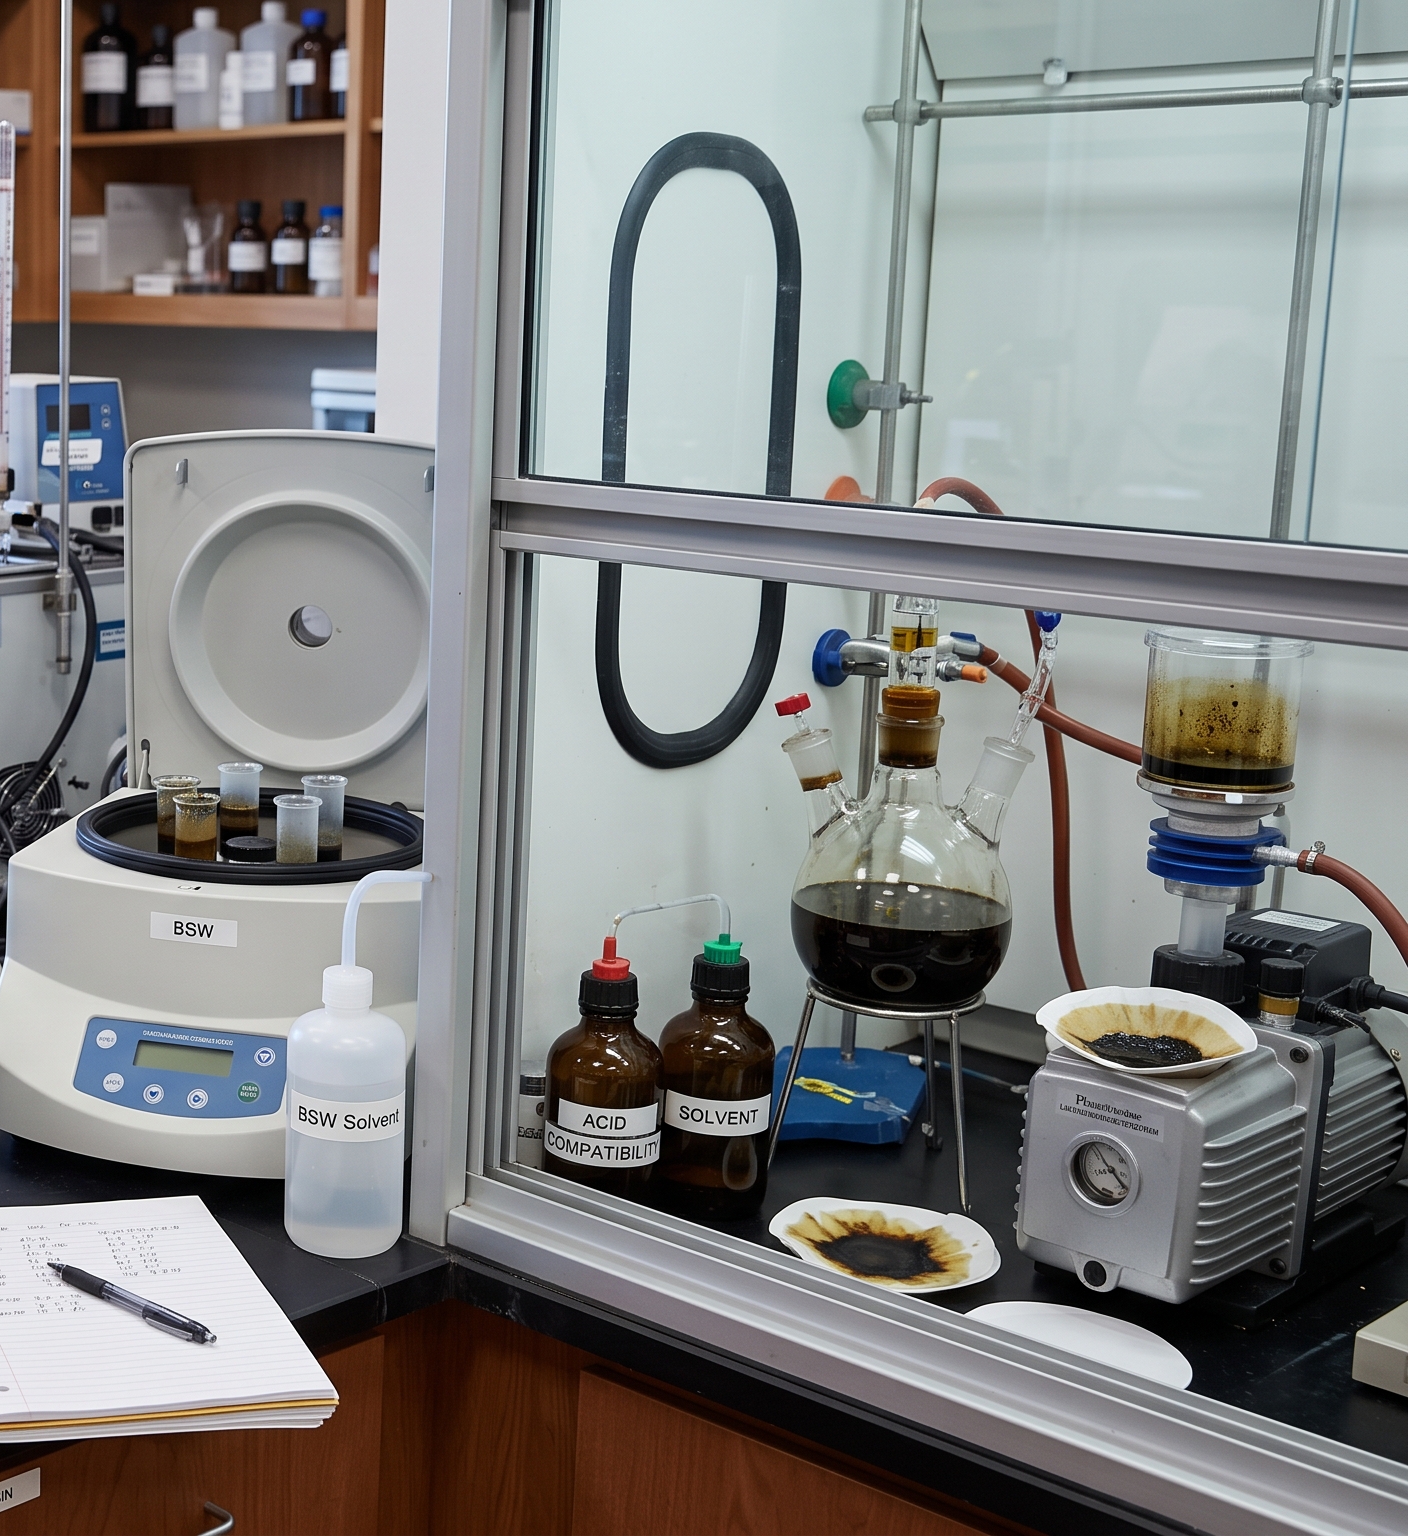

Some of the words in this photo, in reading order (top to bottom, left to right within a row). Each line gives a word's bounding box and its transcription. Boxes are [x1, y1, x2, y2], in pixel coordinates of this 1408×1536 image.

[173, 920, 214, 938] BSW
[298, 1105, 338, 1129] BSW
[343, 1108, 400, 1130] Solvent
[582, 1113, 627, 1131] ACID
[678, 1105, 759, 1126] SOLVENT
[547, 1131, 659, 1161] COMPATIBILITY
